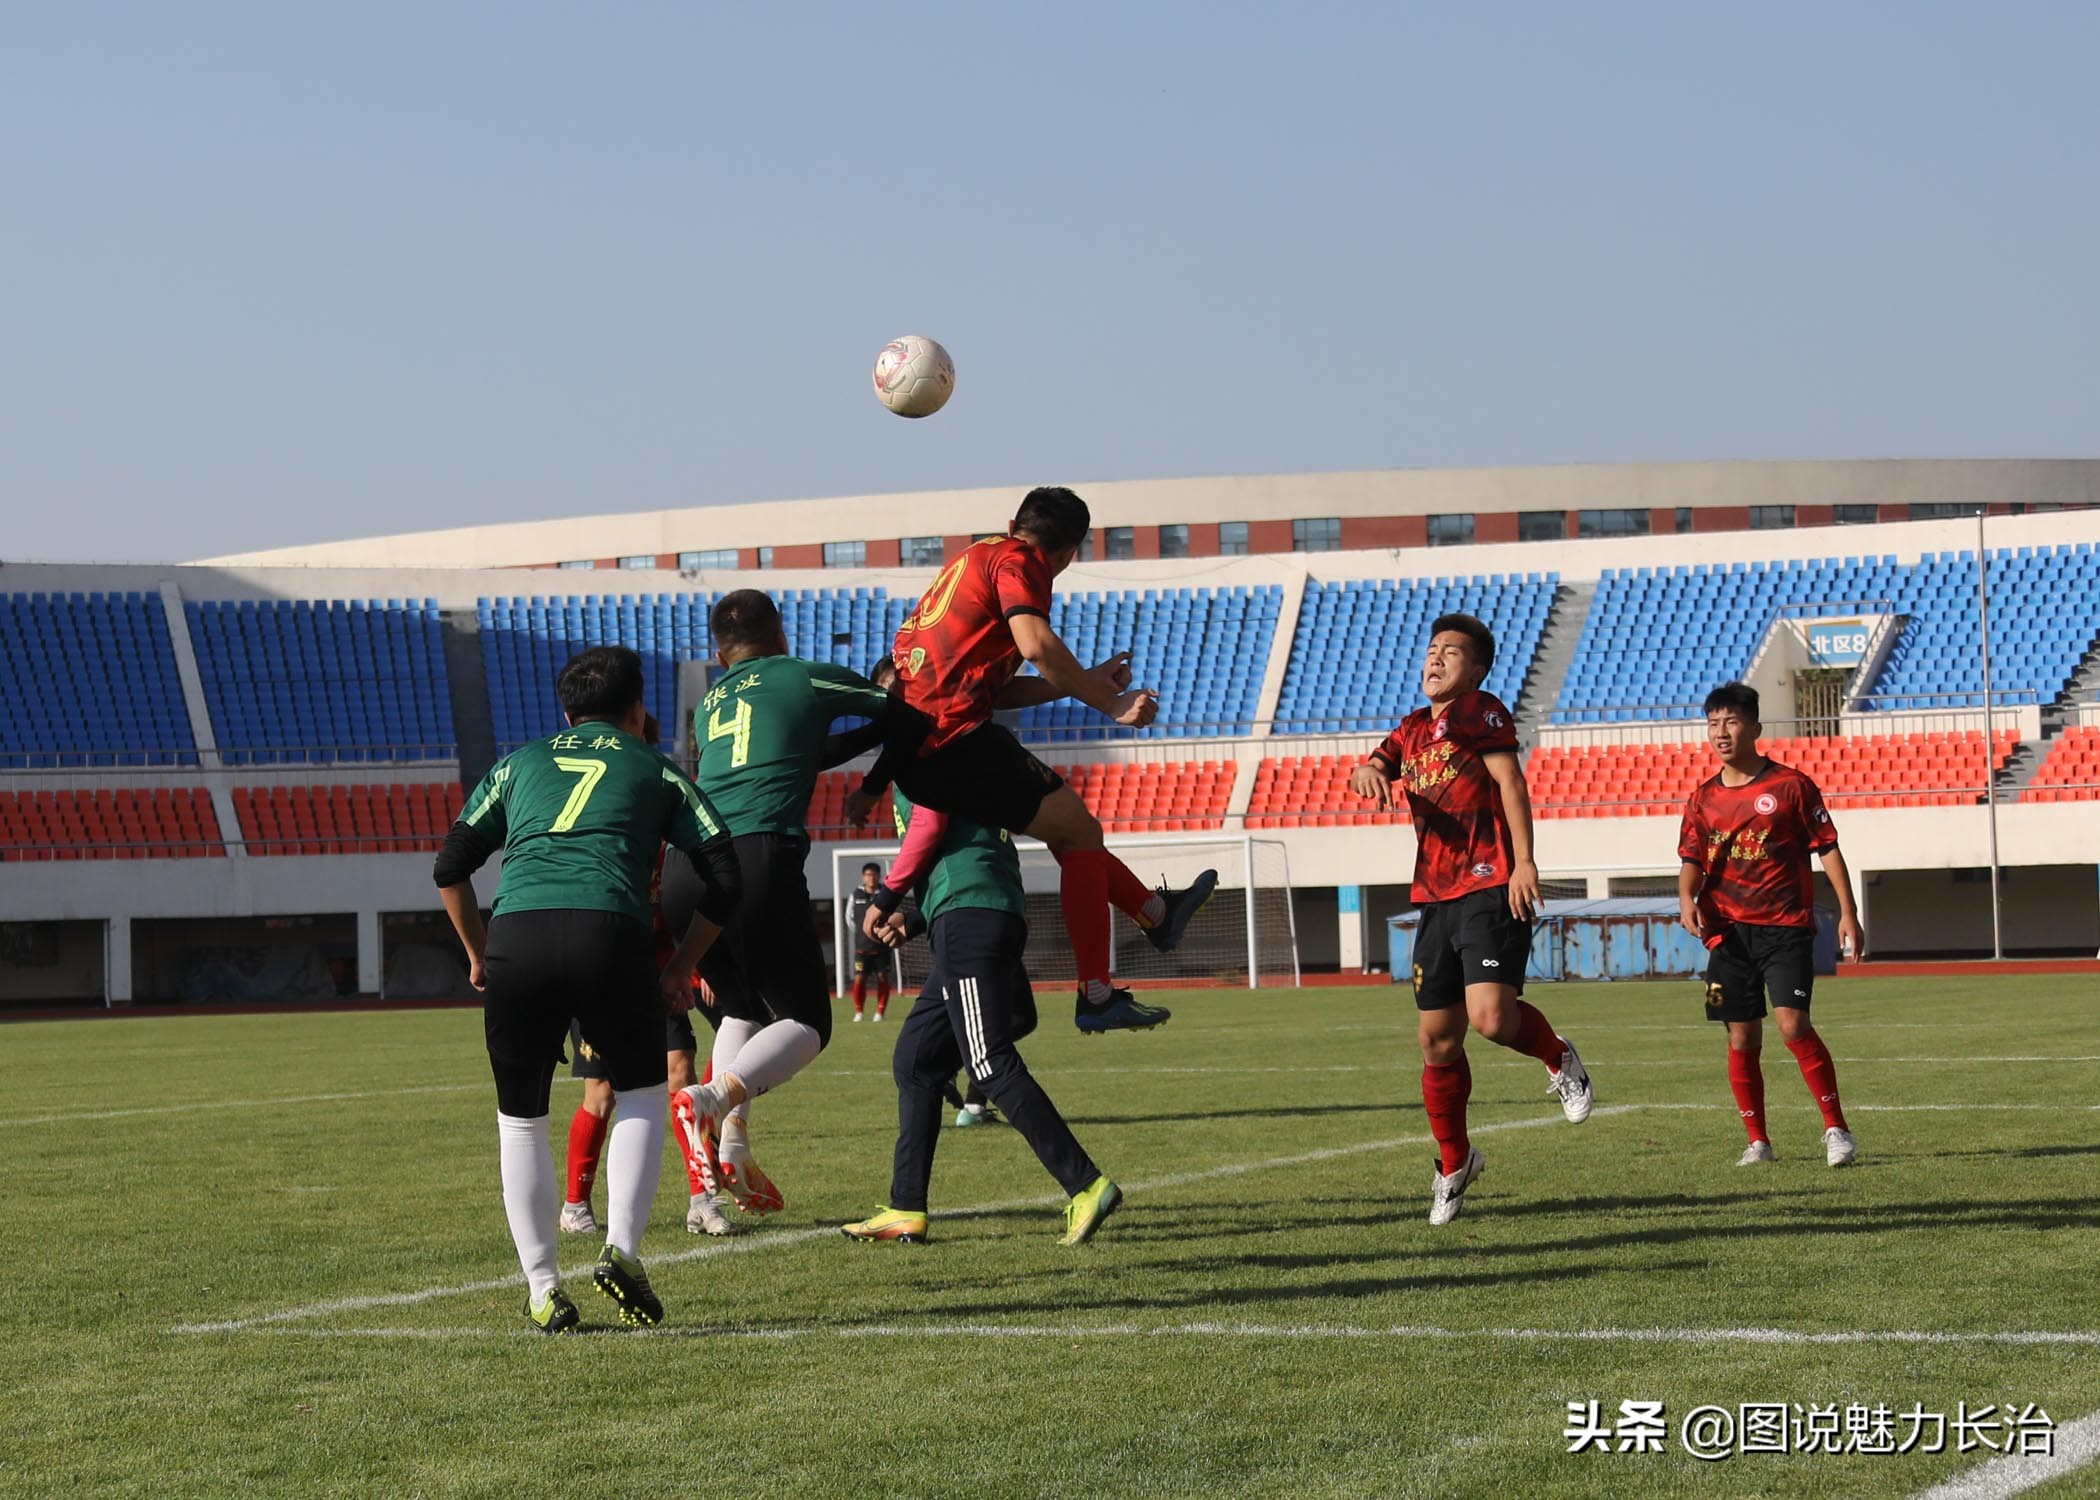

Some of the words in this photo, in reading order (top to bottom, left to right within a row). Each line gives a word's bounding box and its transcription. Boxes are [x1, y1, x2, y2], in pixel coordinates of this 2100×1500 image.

[1810, 634, 1867, 655] 北区8
[703, 673, 762, 711] 张波
[708, 697, 753, 769] 4
[548, 756, 608, 833] 7
